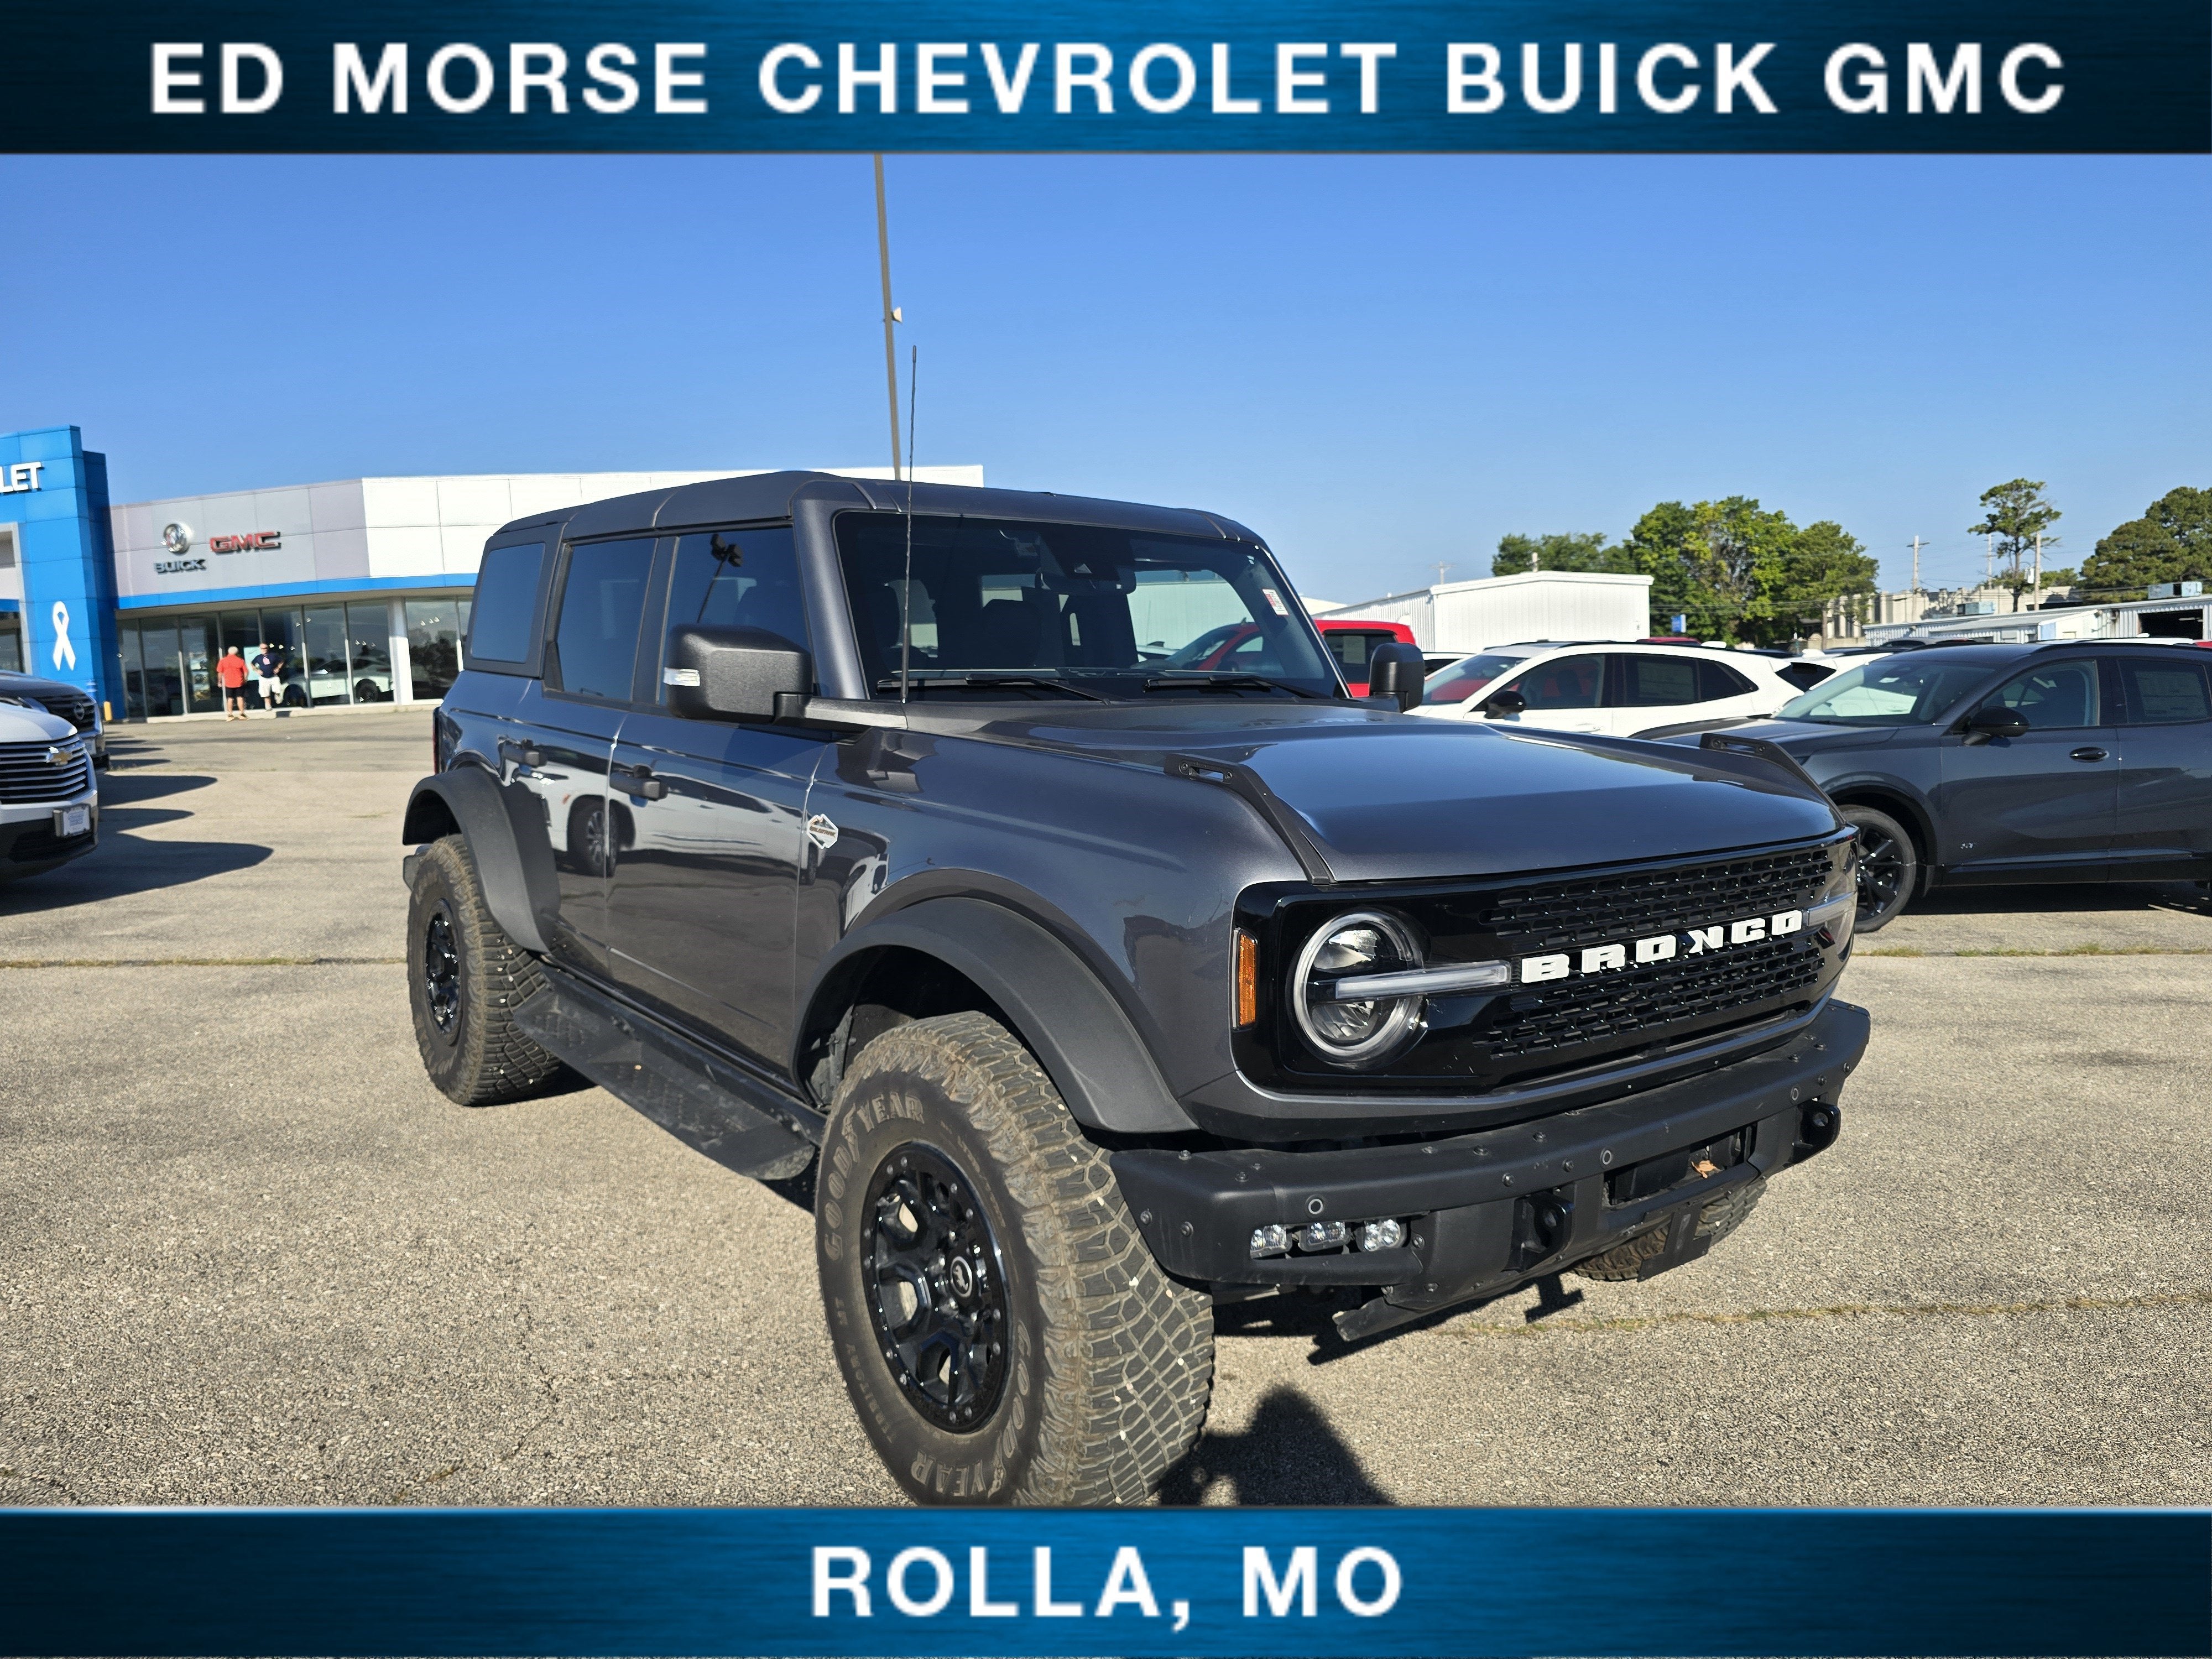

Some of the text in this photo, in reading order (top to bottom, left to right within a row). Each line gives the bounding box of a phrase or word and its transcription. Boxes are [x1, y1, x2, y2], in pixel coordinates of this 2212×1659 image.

[210, 531, 280, 554] GMC
[154, 559, 206, 574] BUICK
[1521, 910, 1803, 984] BRONCO
